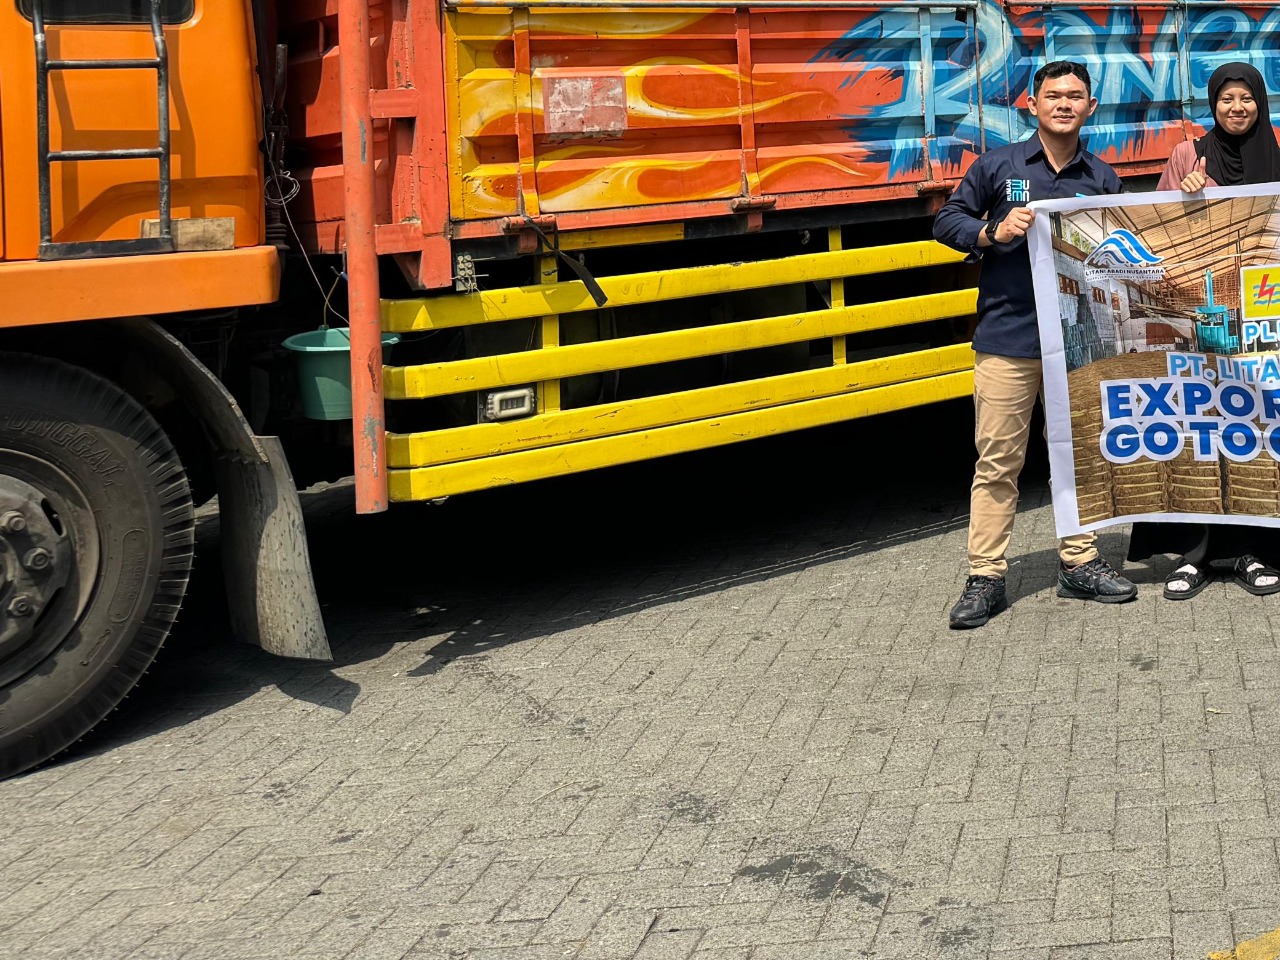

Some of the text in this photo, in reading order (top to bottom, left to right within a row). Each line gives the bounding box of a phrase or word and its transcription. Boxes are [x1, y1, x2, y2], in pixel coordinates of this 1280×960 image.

[1170, 354, 1217, 380] PT.
[1105, 423, 1179, 458] GO
[1195, 421, 1257, 457] TO
